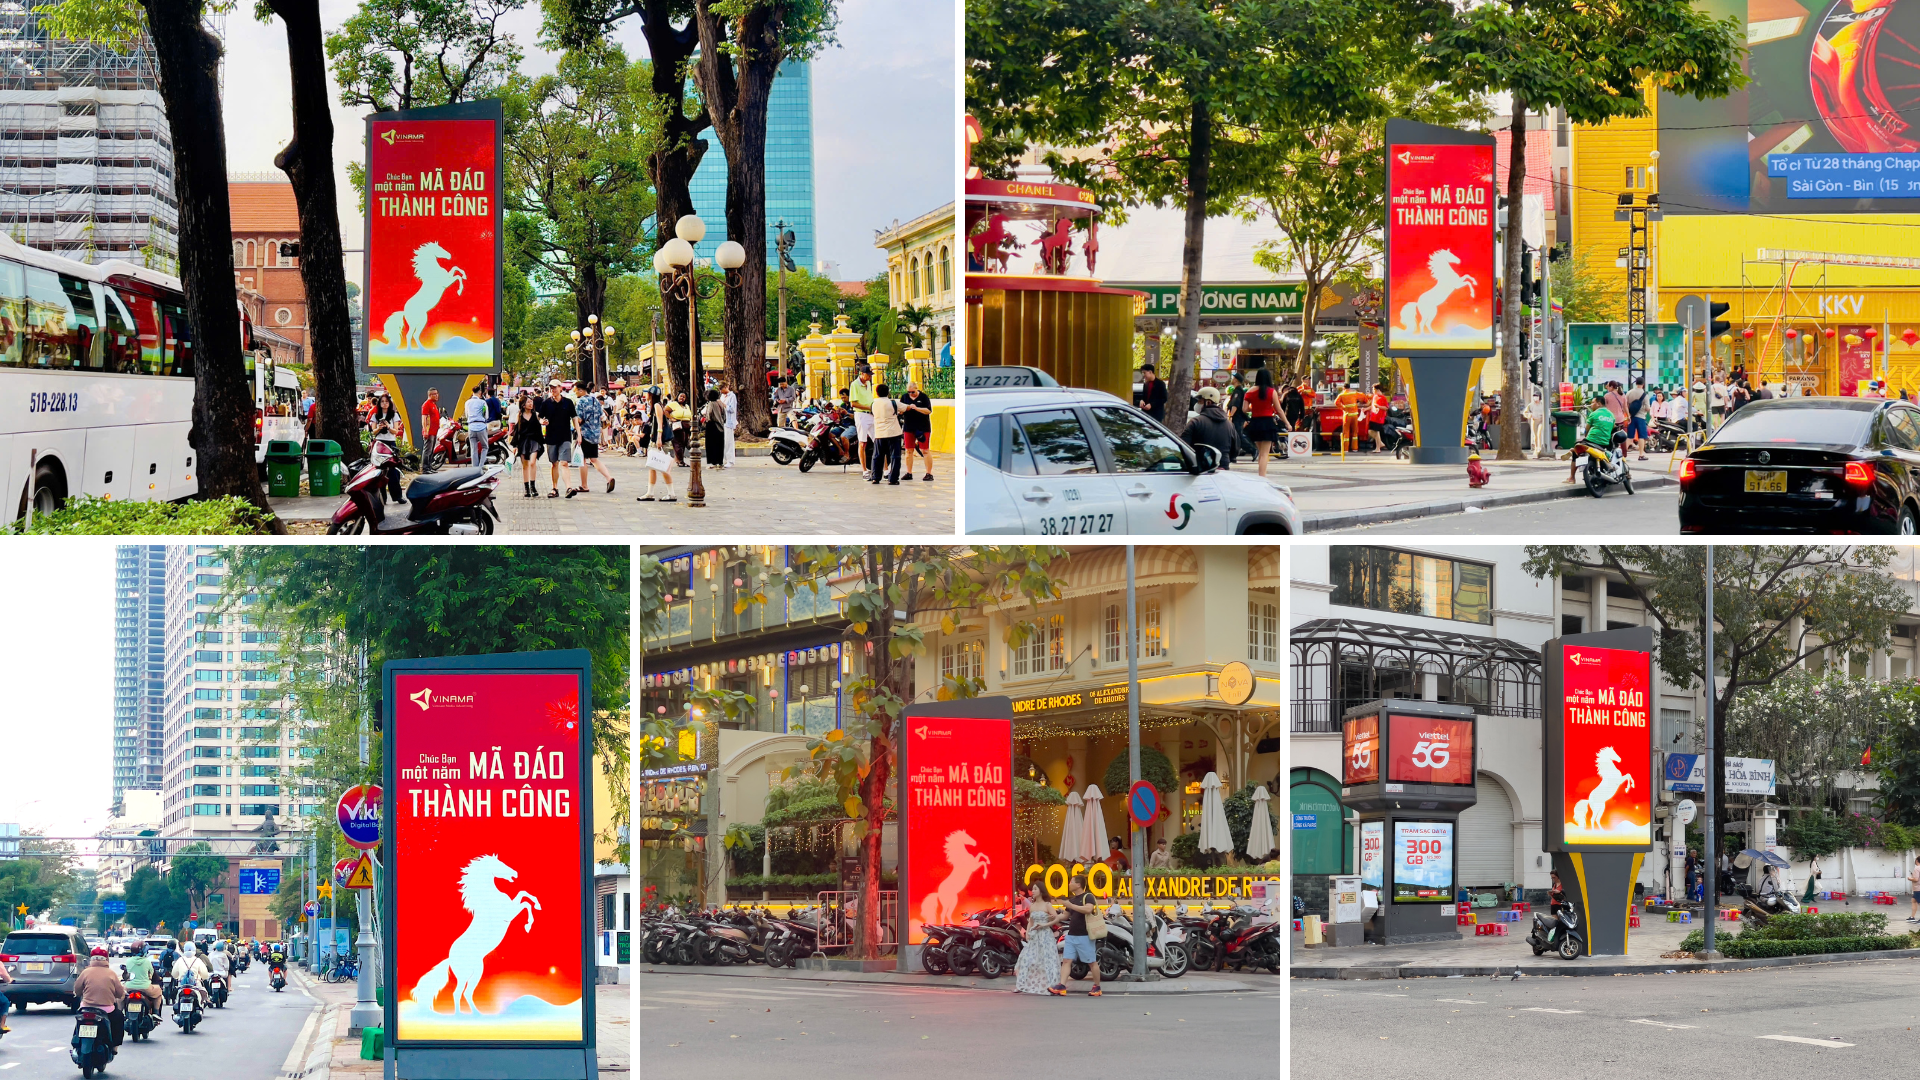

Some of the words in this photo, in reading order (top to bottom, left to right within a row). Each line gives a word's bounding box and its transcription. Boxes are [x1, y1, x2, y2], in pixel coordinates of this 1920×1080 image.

[1804, 158, 1821, 170] Từ
[1823, 158, 1840, 170] 28
[1842, 156, 1882, 173] tháng
[1884, 157, 1920, 172] Chạp
[375, 181, 392, 193] một
[395, 181, 415, 191] năm
[420, 168, 444, 191] MÃ
[450, 168, 484, 191] ĐÁO
[401, 173, 412, 181] Bạn
[1792, 180, 1814, 192] Sài
[1815, 179, 1844, 192] Gòn
[1006, 184, 1055, 197] CHANEL
[1393, 195, 1408, 205] một
[1410, 195, 1427, 203] năm
[1430, 184, 1451, 204] MÃ
[1455, 184, 1485, 204] ĐÁO
[379, 193, 435, 217] THÀNH
[442, 193, 488, 216] CÔNG
[1396, 205, 1444, 226] THÀNH
[1448, 205, 1488, 226] CÔNG
[1251, 292, 1297, 309] NAM
[1819, 295, 1865, 315] KKV
[993, 376, 1010, 386] 27
[1013, 376, 1030, 386] 27
[30, 392, 78, 413] 51B-228.13
[1040, 516, 1076, 535] 38.27
[1079, 515, 1096, 534] 27
[1098, 513, 1114, 532] 27
[432, 695, 474, 703] VINAMA
[1037, 697, 1047, 710] DE
[1048, 693, 1082, 709] RHODES
[1566, 695, 1579, 704] một
[1581, 696, 1595, 704] năm
[1598, 687, 1616, 705] MÃ
[1619, 688, 1643, 707] ĐÁO
[1569, 706, 1610, 725] THÀNH
[1614, 708, 1646, 727] CÔNG
[1355, 731, 1370, 741] viettel
[1419, 732, 1450, 741] viettel
[419, 753, 439, 764] Chúc
[441, 753, 457, 765] Bạn
[1352, 741, 1370, 769] 5G
[1412, 741, 1450, 768] 5G
[402, 766, 428, 782] một
[432, 767, 461, 780] năm
[469, 746, 505, 780] MÃ
[513, 746, 564, 780] ĐÁO
[910, 774, 926, 784] một
[928, 774, 945, 783] năm
[949, 762, 969, 783] MÃ
[974, 762, 1002, 783] ĐÁO
[1749, 770, 1771, 782] BÌNH
[408, 783, 491, 818] THÀNH
[502, 783, 570, 818] CÔNG
[914, 785, 962, 806] THÀNH
[967, 786, 1006, 807] CÔNG
[1364, 837, 1380, 851] 300
[1407, 840, 1442, 854] 300
[1364, 853, 1373, 862] GB
[1407, 855, 1424, 865] GB
[1215, 877, 1238, 897] DE
